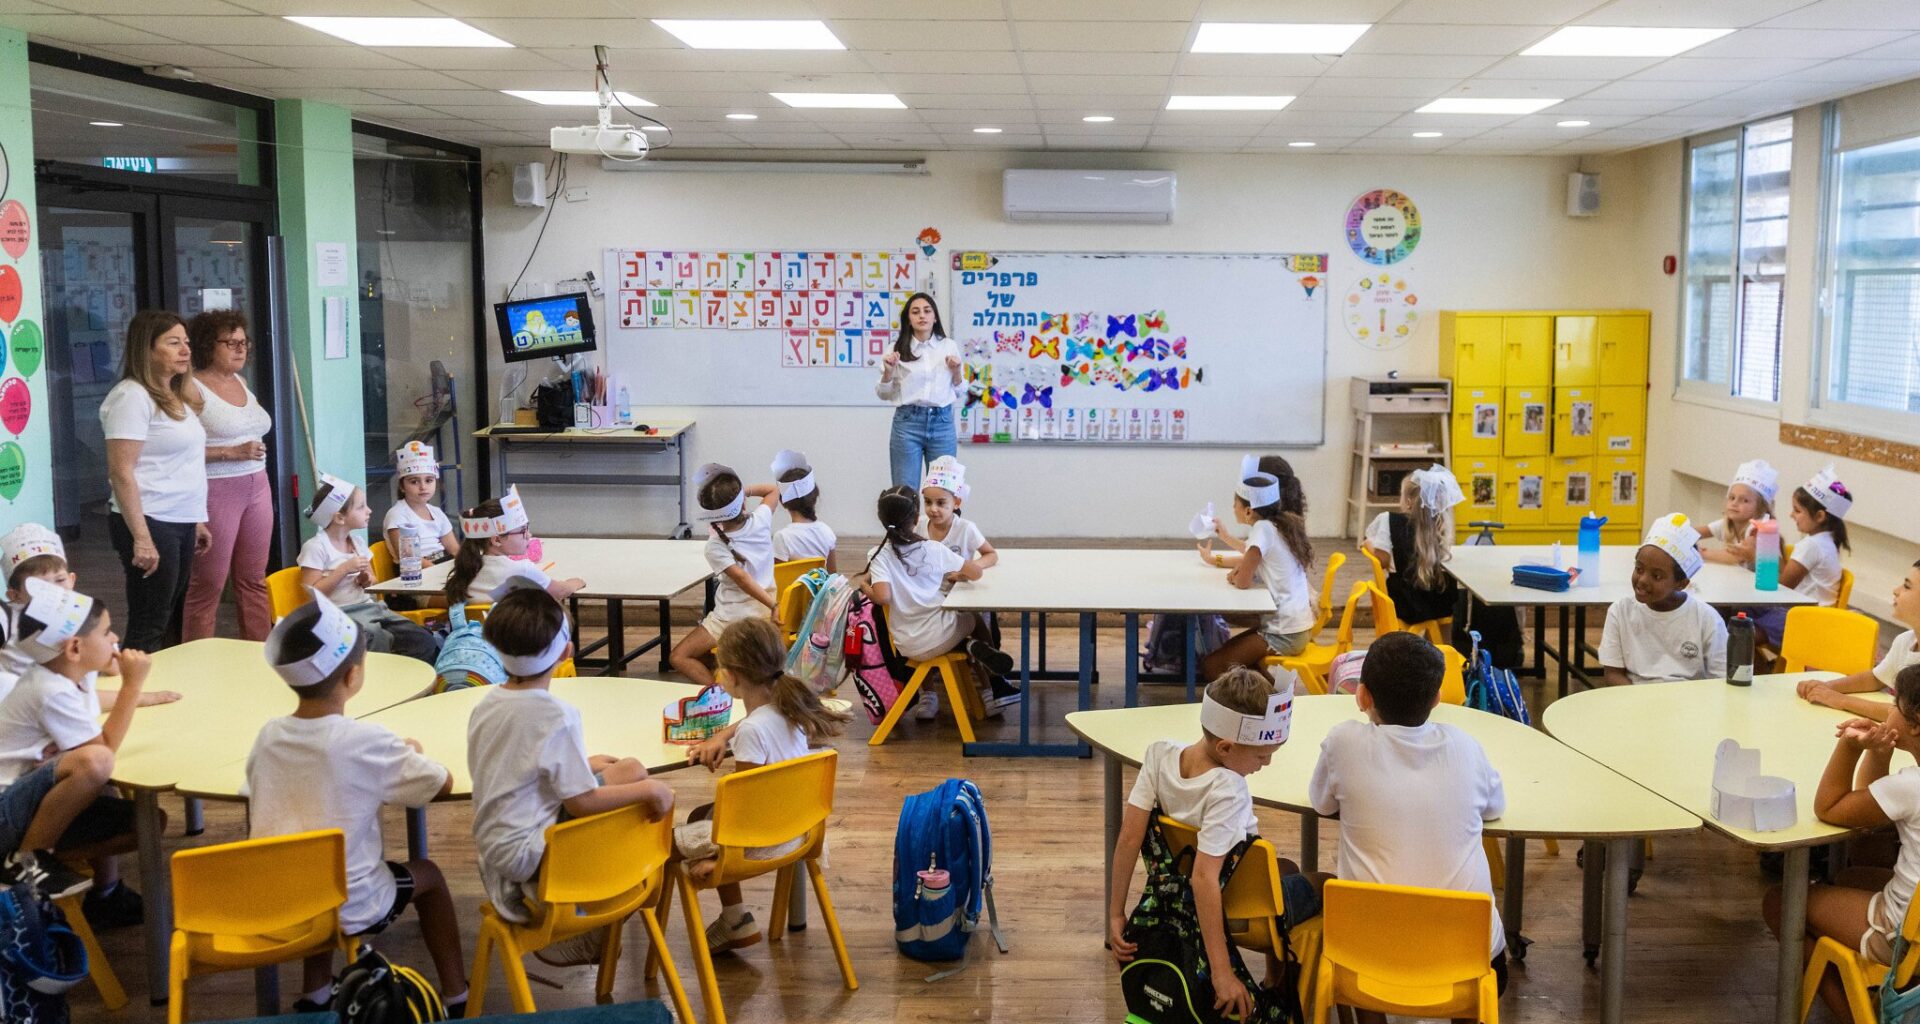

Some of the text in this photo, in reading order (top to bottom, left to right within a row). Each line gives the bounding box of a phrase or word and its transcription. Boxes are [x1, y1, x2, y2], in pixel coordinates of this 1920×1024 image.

[655, 261, 664, 272] י
[678, 262, 692, 278] ט
[706, 262, 721, 278] ח
[736, 262, 747, 279] ז
[764, 261, 772, 278] ו
[788, 262, 802, 279] ה
[814, 262, 829, 278] ד
[843, 262, 855, 279] ג
[868, 263, 883, 279] ב
[896, 263, 910, 279] א
[962, 271, 1037, 287] פרפרים
[624, 299, 642, 316] ת
[651, 299, 668, 316] ש
[680, 299, 695, 316] ר
[988, 291, 1015, 308] של
[707, 300, 722, 326] ק
[734, 301, 748, 317] צ
[762, 300, 775, 317] פ
[788, 300, 803, 317] ע
[814, 300, 830, 317] ס
[843, 301, 855, 317] נ
[868, 301, 885, 317] מ
[973, 309, 1037, 326] התחלה
[516, 335, 528, 347] ט
[788, 338, 884, 365] ם ן ף ץ
[961, 408, 968, 418] 0
[1005, 408, 1011, 419] 2
[1026, 408, 1033, 418] 3
[1046, 408, 1054, 418] 4
[1068, 408, 1075, 418] 5
[1089, 408, 1097, 418] 6
[1111, 408, 1118, 418] 7
[1131, 408, 1139, 418] 8
[1153, 408, 1160, 418] 9
[1173, 409, 1185, 419] 10
